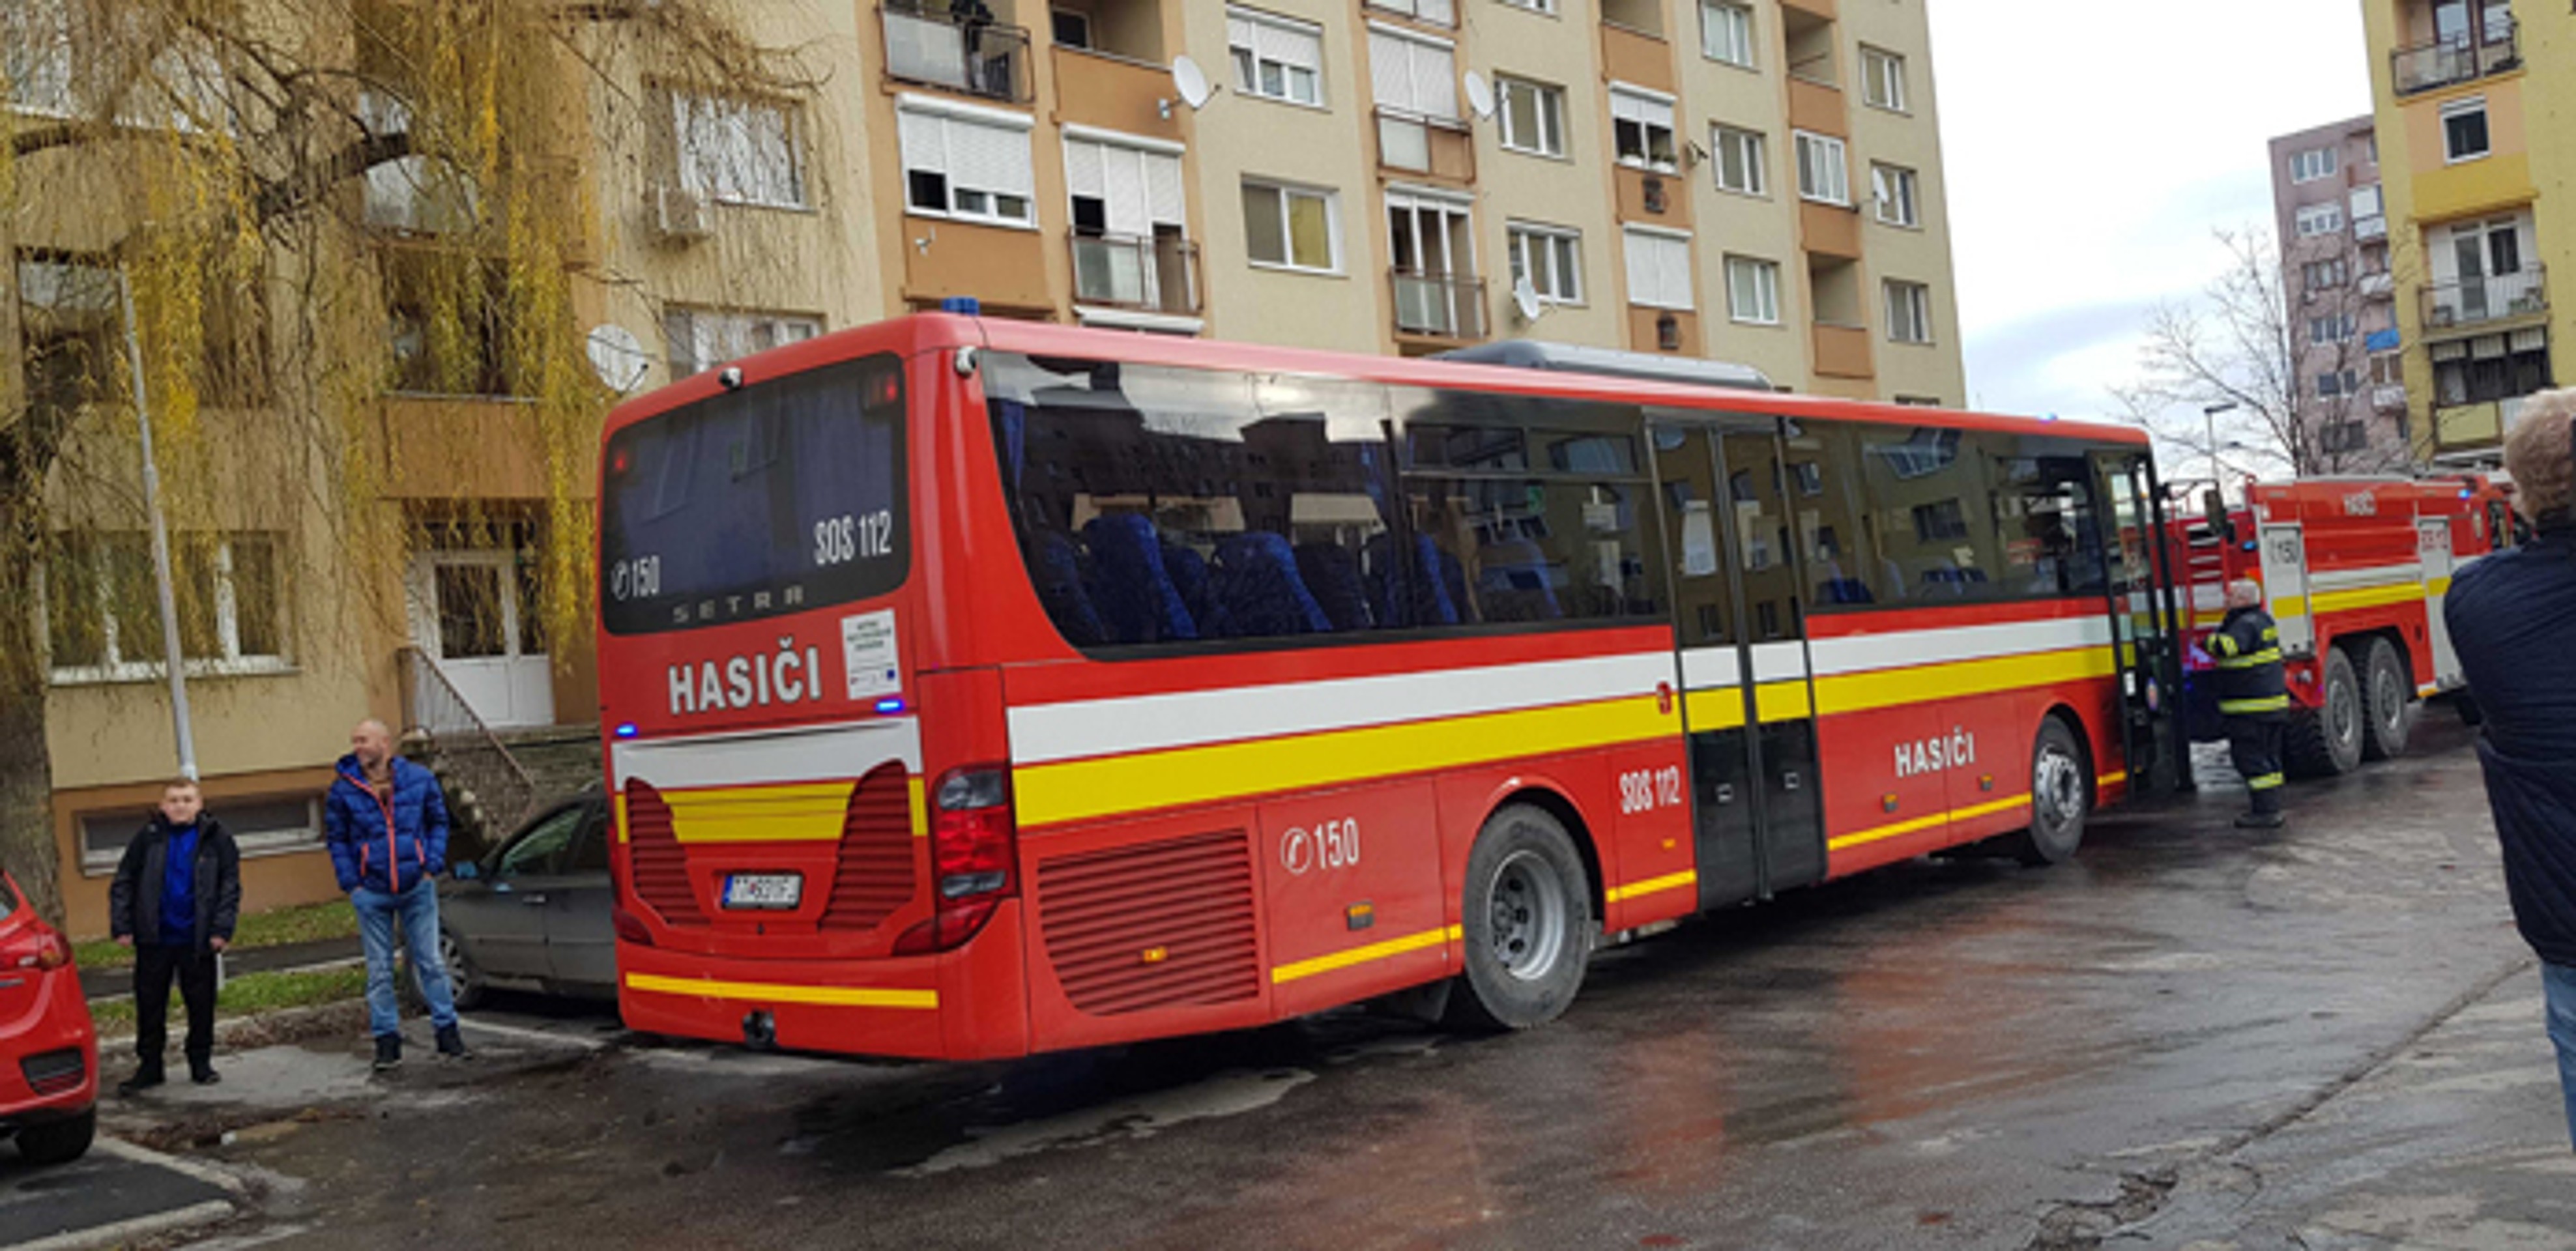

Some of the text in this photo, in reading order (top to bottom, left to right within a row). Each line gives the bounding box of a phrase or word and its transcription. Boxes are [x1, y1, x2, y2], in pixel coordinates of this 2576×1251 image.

[814, 508, 891, 566] SOS 112
[632, 554, 660, 597] 150
[673, 585, 803, 624] SETRA
[668, 634, 822, 715] HASIČI
[1894, 724, 1976, 779] HASIČI
[1619, 765, 1682, 815] SOS 112
[1313, 816, 1360, 870] 150
